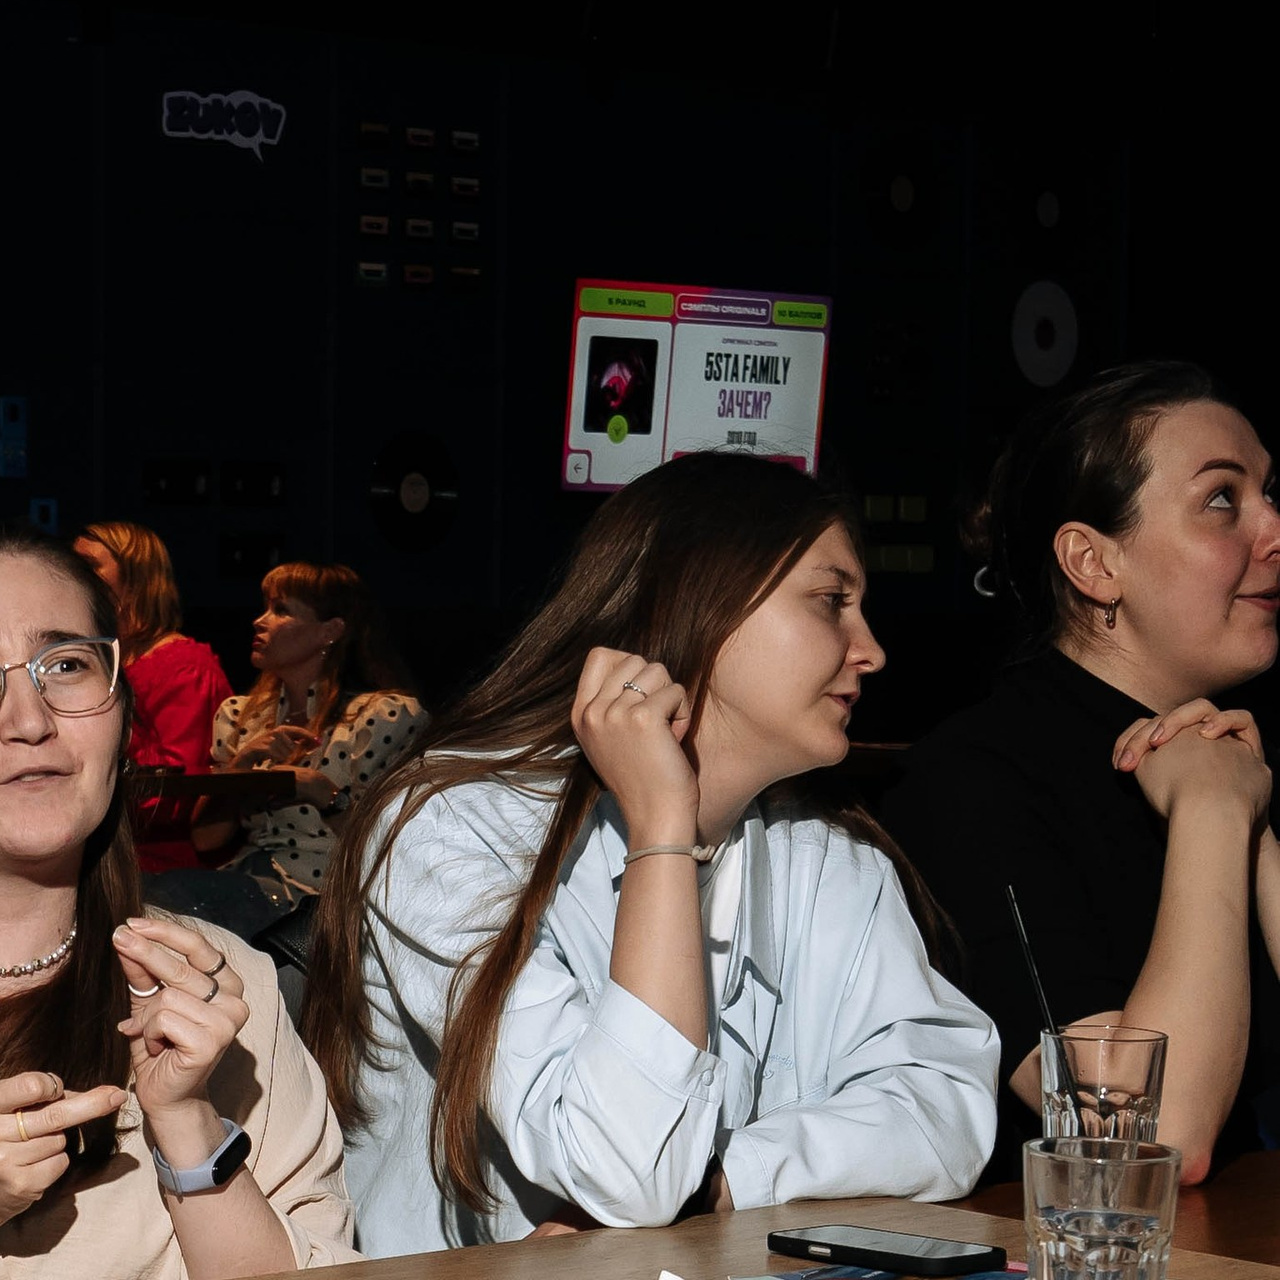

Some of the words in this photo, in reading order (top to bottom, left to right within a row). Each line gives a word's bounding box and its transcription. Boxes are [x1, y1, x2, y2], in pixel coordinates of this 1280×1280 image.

[704, 352, 739, 382] 5STA
[742, 354, 791, 385] FAMILY
[717, 389, 771, 420] ЗАЧЕМ?
